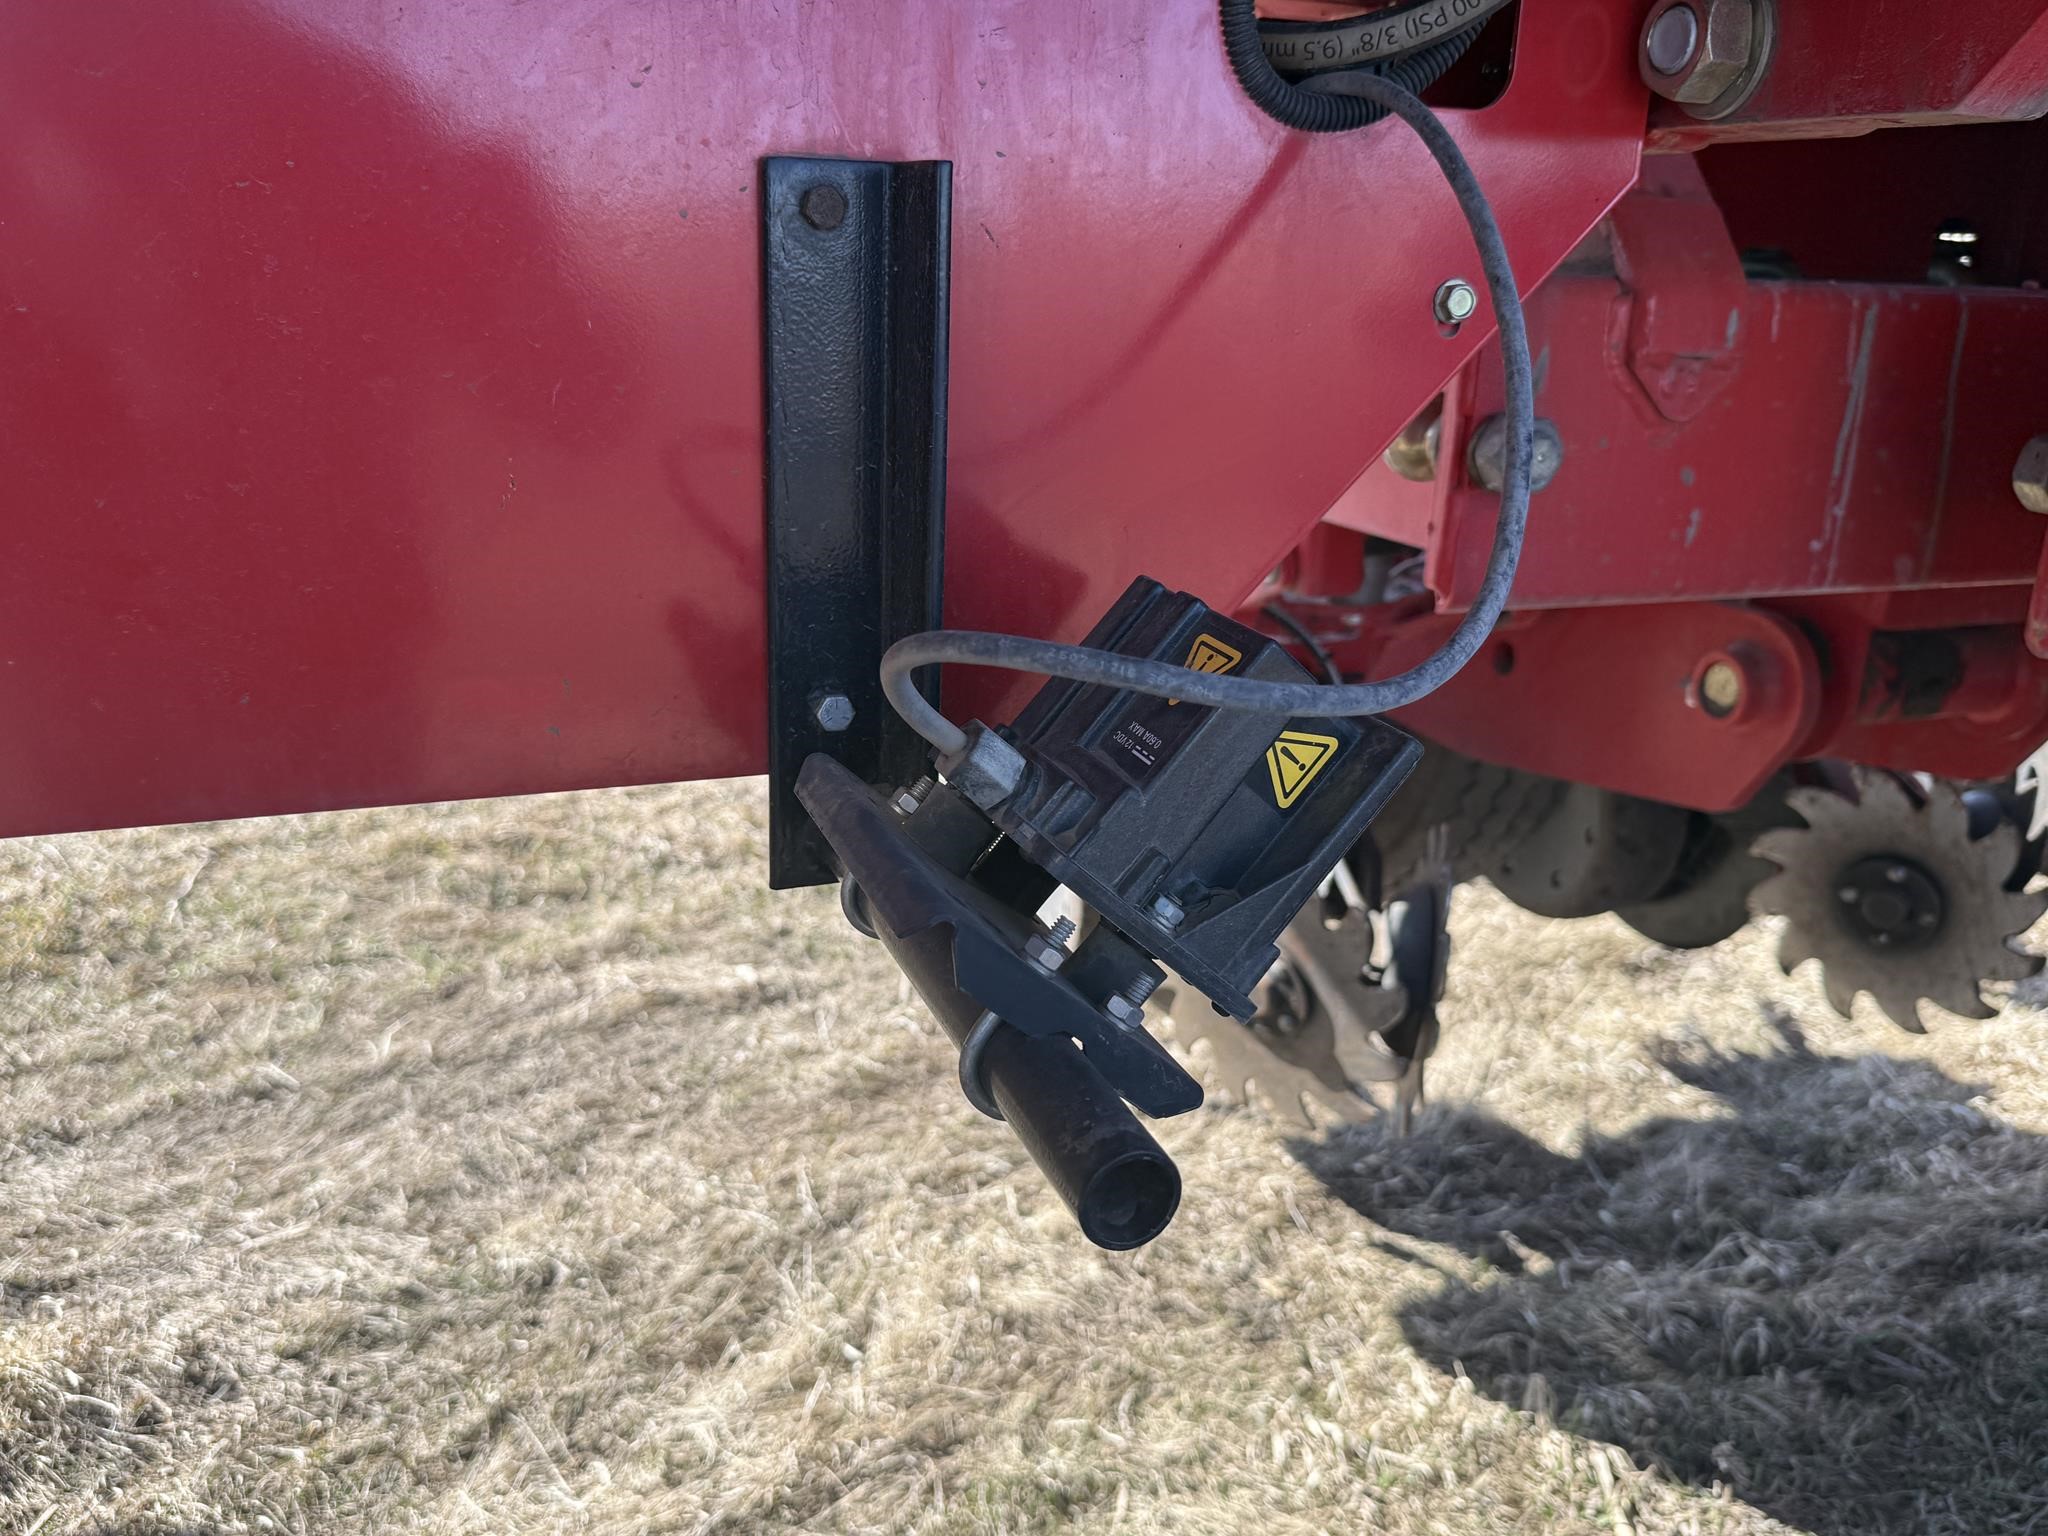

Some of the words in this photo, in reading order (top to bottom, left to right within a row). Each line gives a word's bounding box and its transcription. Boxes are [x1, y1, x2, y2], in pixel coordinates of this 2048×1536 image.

[1405, 6, 1448, 38] PSI)
[1304, 36, 1342, 61] (9.5
[1352, 25, 1398, 56] 3/8"
[1128, 721, 1145, 737] MAX
[1142, 730, 1162, 749] 0.60A
